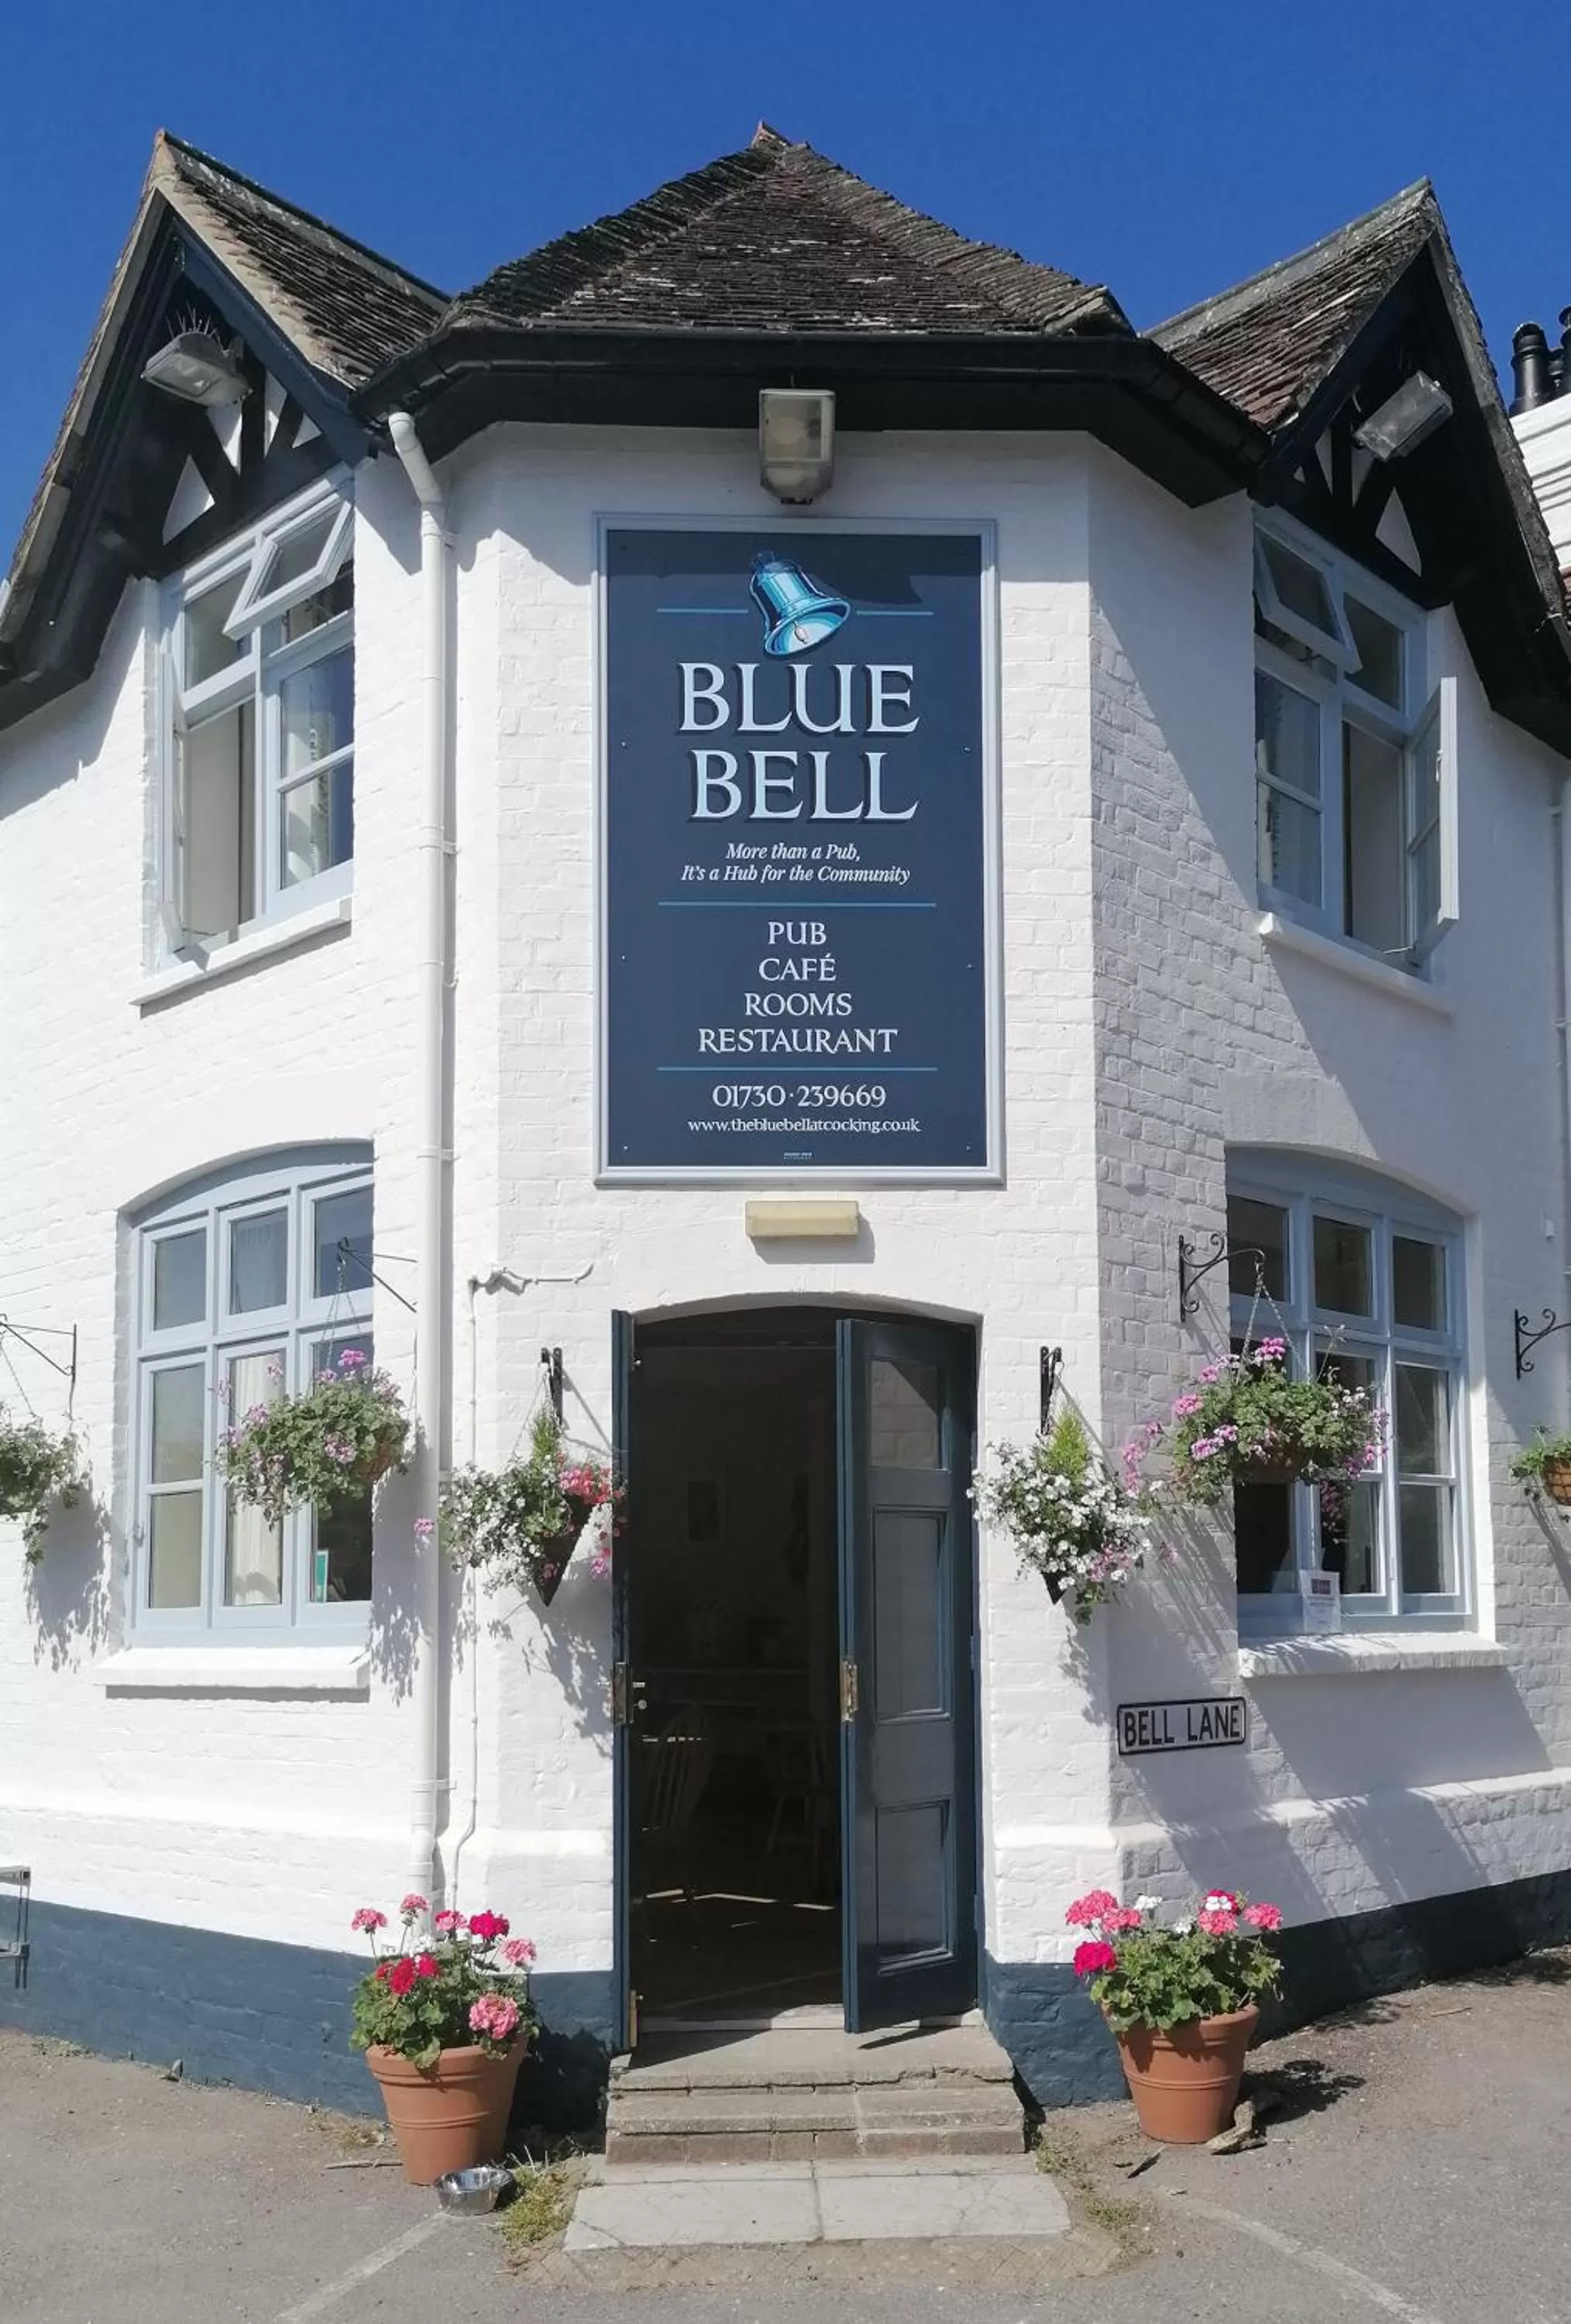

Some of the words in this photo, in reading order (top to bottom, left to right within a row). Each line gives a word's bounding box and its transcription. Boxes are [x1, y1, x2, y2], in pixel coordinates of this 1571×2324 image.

[679, 662, 920, 733] BLUE
[692, 749, 918, 820] BELL
[725, 842, 768, 859] More
[771, 842, 808, 860] than
[811, 846, 822, 860] a
[825, 842, 861, 862] Pub,
[681, 865, 706, 881] It's
[708, 868, 720, 881] a
[723, 864, 758, 882] Hub
[760, 864, 786, 884] for
[789, 864, 814, 882] the
[817, 865, 910, 885] Community
[768, 921, 827, 945] PUB
[758, 952, 837, 982] CAFÉ
[744, 992, 853, 1017] ROOMS
[698, 1028, 899, 1054] RESTAURANT
[687, 1117, 922, 1134] www.thebluebellatcocking.co.uk
[1124, 1710, 1175, 1747] BELL
[1187, 1704, 1240, 1742] LANE
